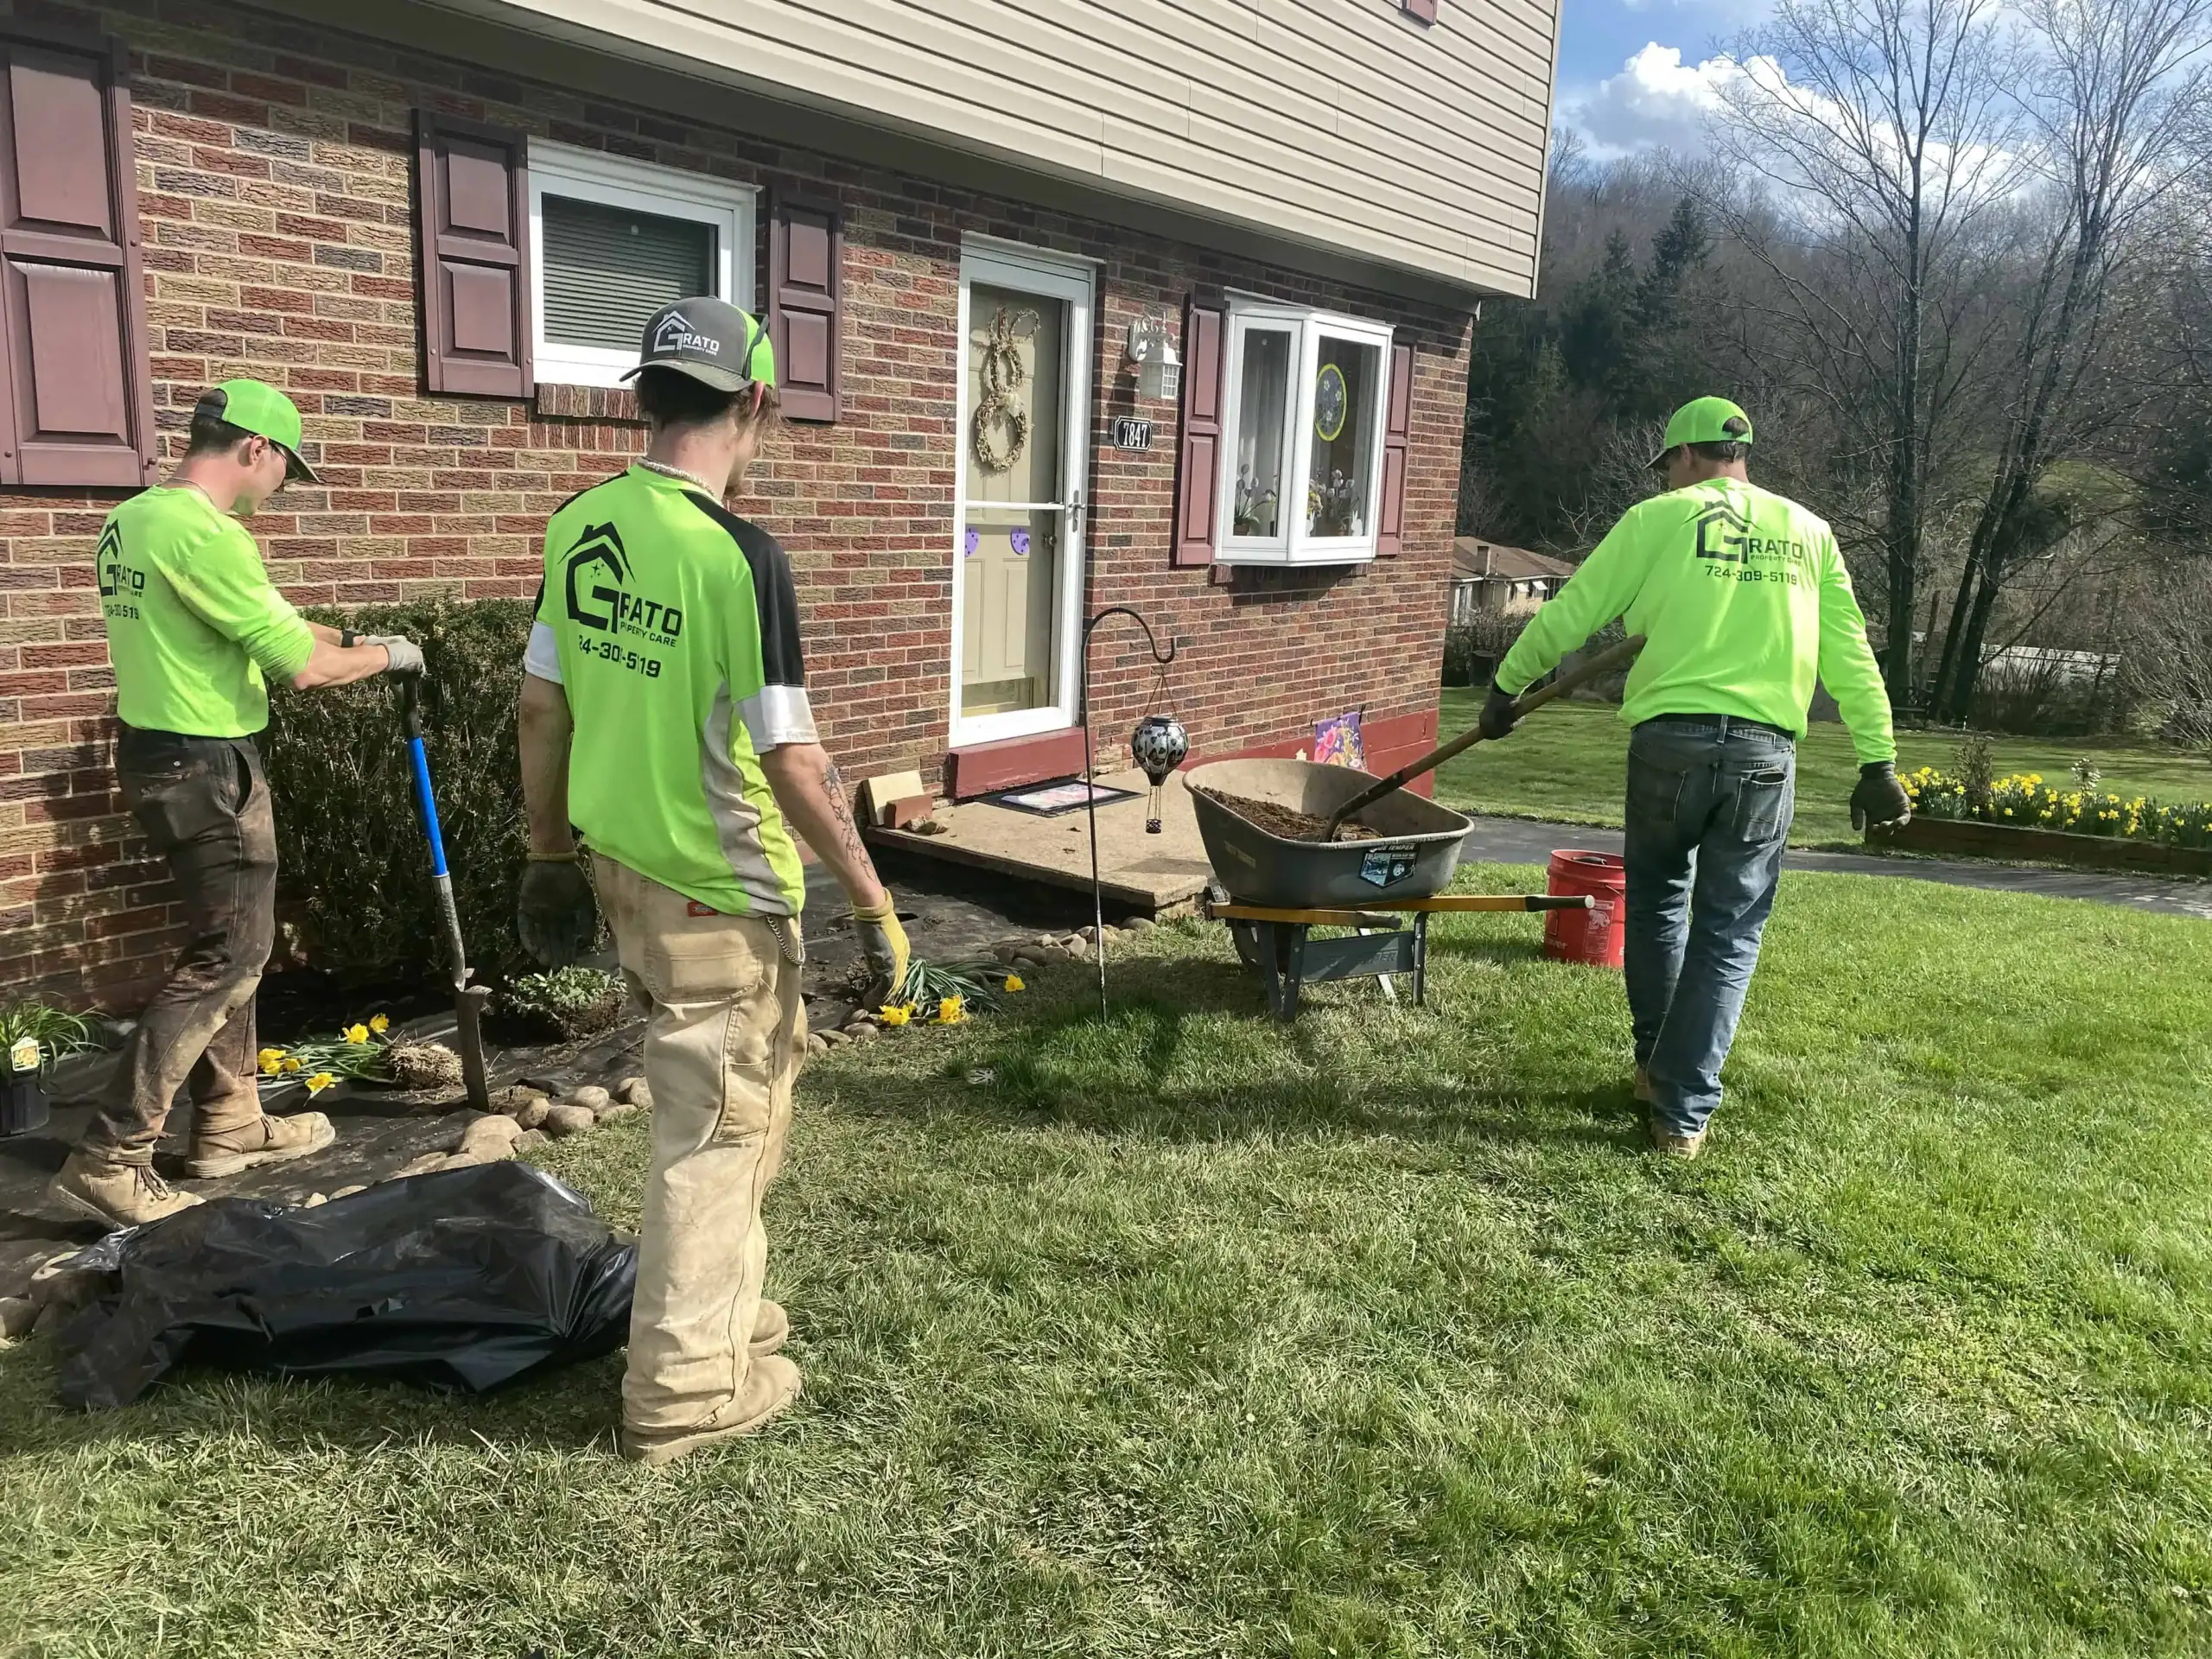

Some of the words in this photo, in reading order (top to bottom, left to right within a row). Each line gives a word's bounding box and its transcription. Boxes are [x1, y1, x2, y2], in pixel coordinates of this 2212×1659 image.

[653, 317, 720, 353] GRATO
[1123, 422, 1147, 447] 7847
[1697, 510, 1803, 564] GRATO
[1750, 554, 1786, 563] PROPERTY
[1705, 565, 1797, 586] 724-309-5119
[566, 543, 683, 637] GRATO
[649, 632, 677, 648] CARE
